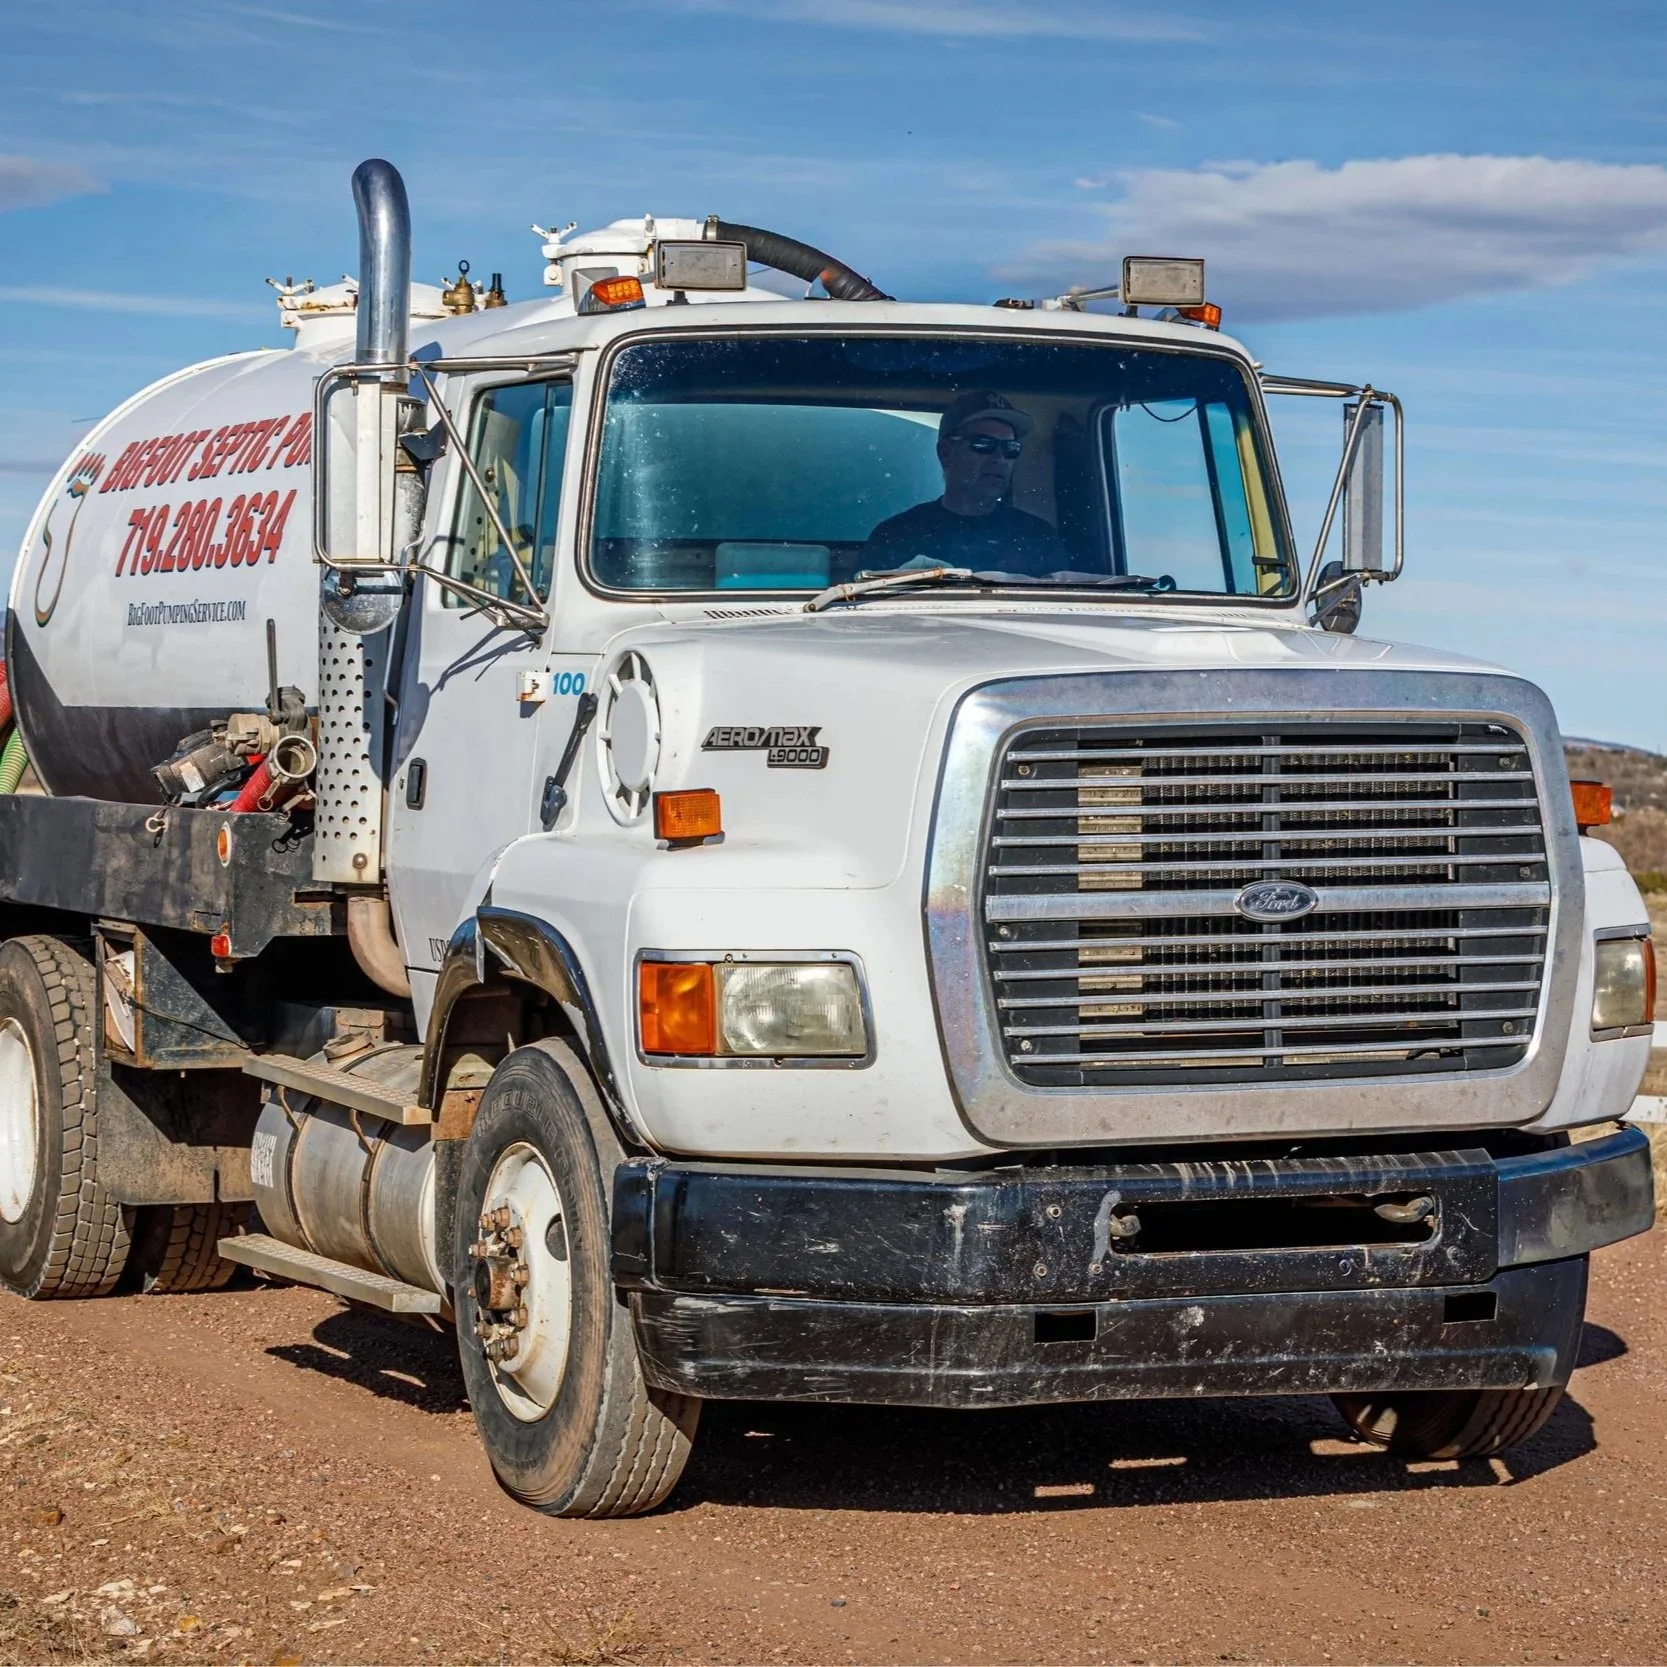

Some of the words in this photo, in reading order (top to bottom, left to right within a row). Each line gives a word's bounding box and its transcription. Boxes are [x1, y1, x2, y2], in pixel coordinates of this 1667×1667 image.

[99, 429, 212, 493] BIGFOOT
[187, 415, 290, 481] SEPTIC
[266, 411, 312, 468] PU
[115, 489, 297, 577] 719.280.3634
[553, 672, 585, 695] 100
[1254, 888, 1301, 910] Ford
